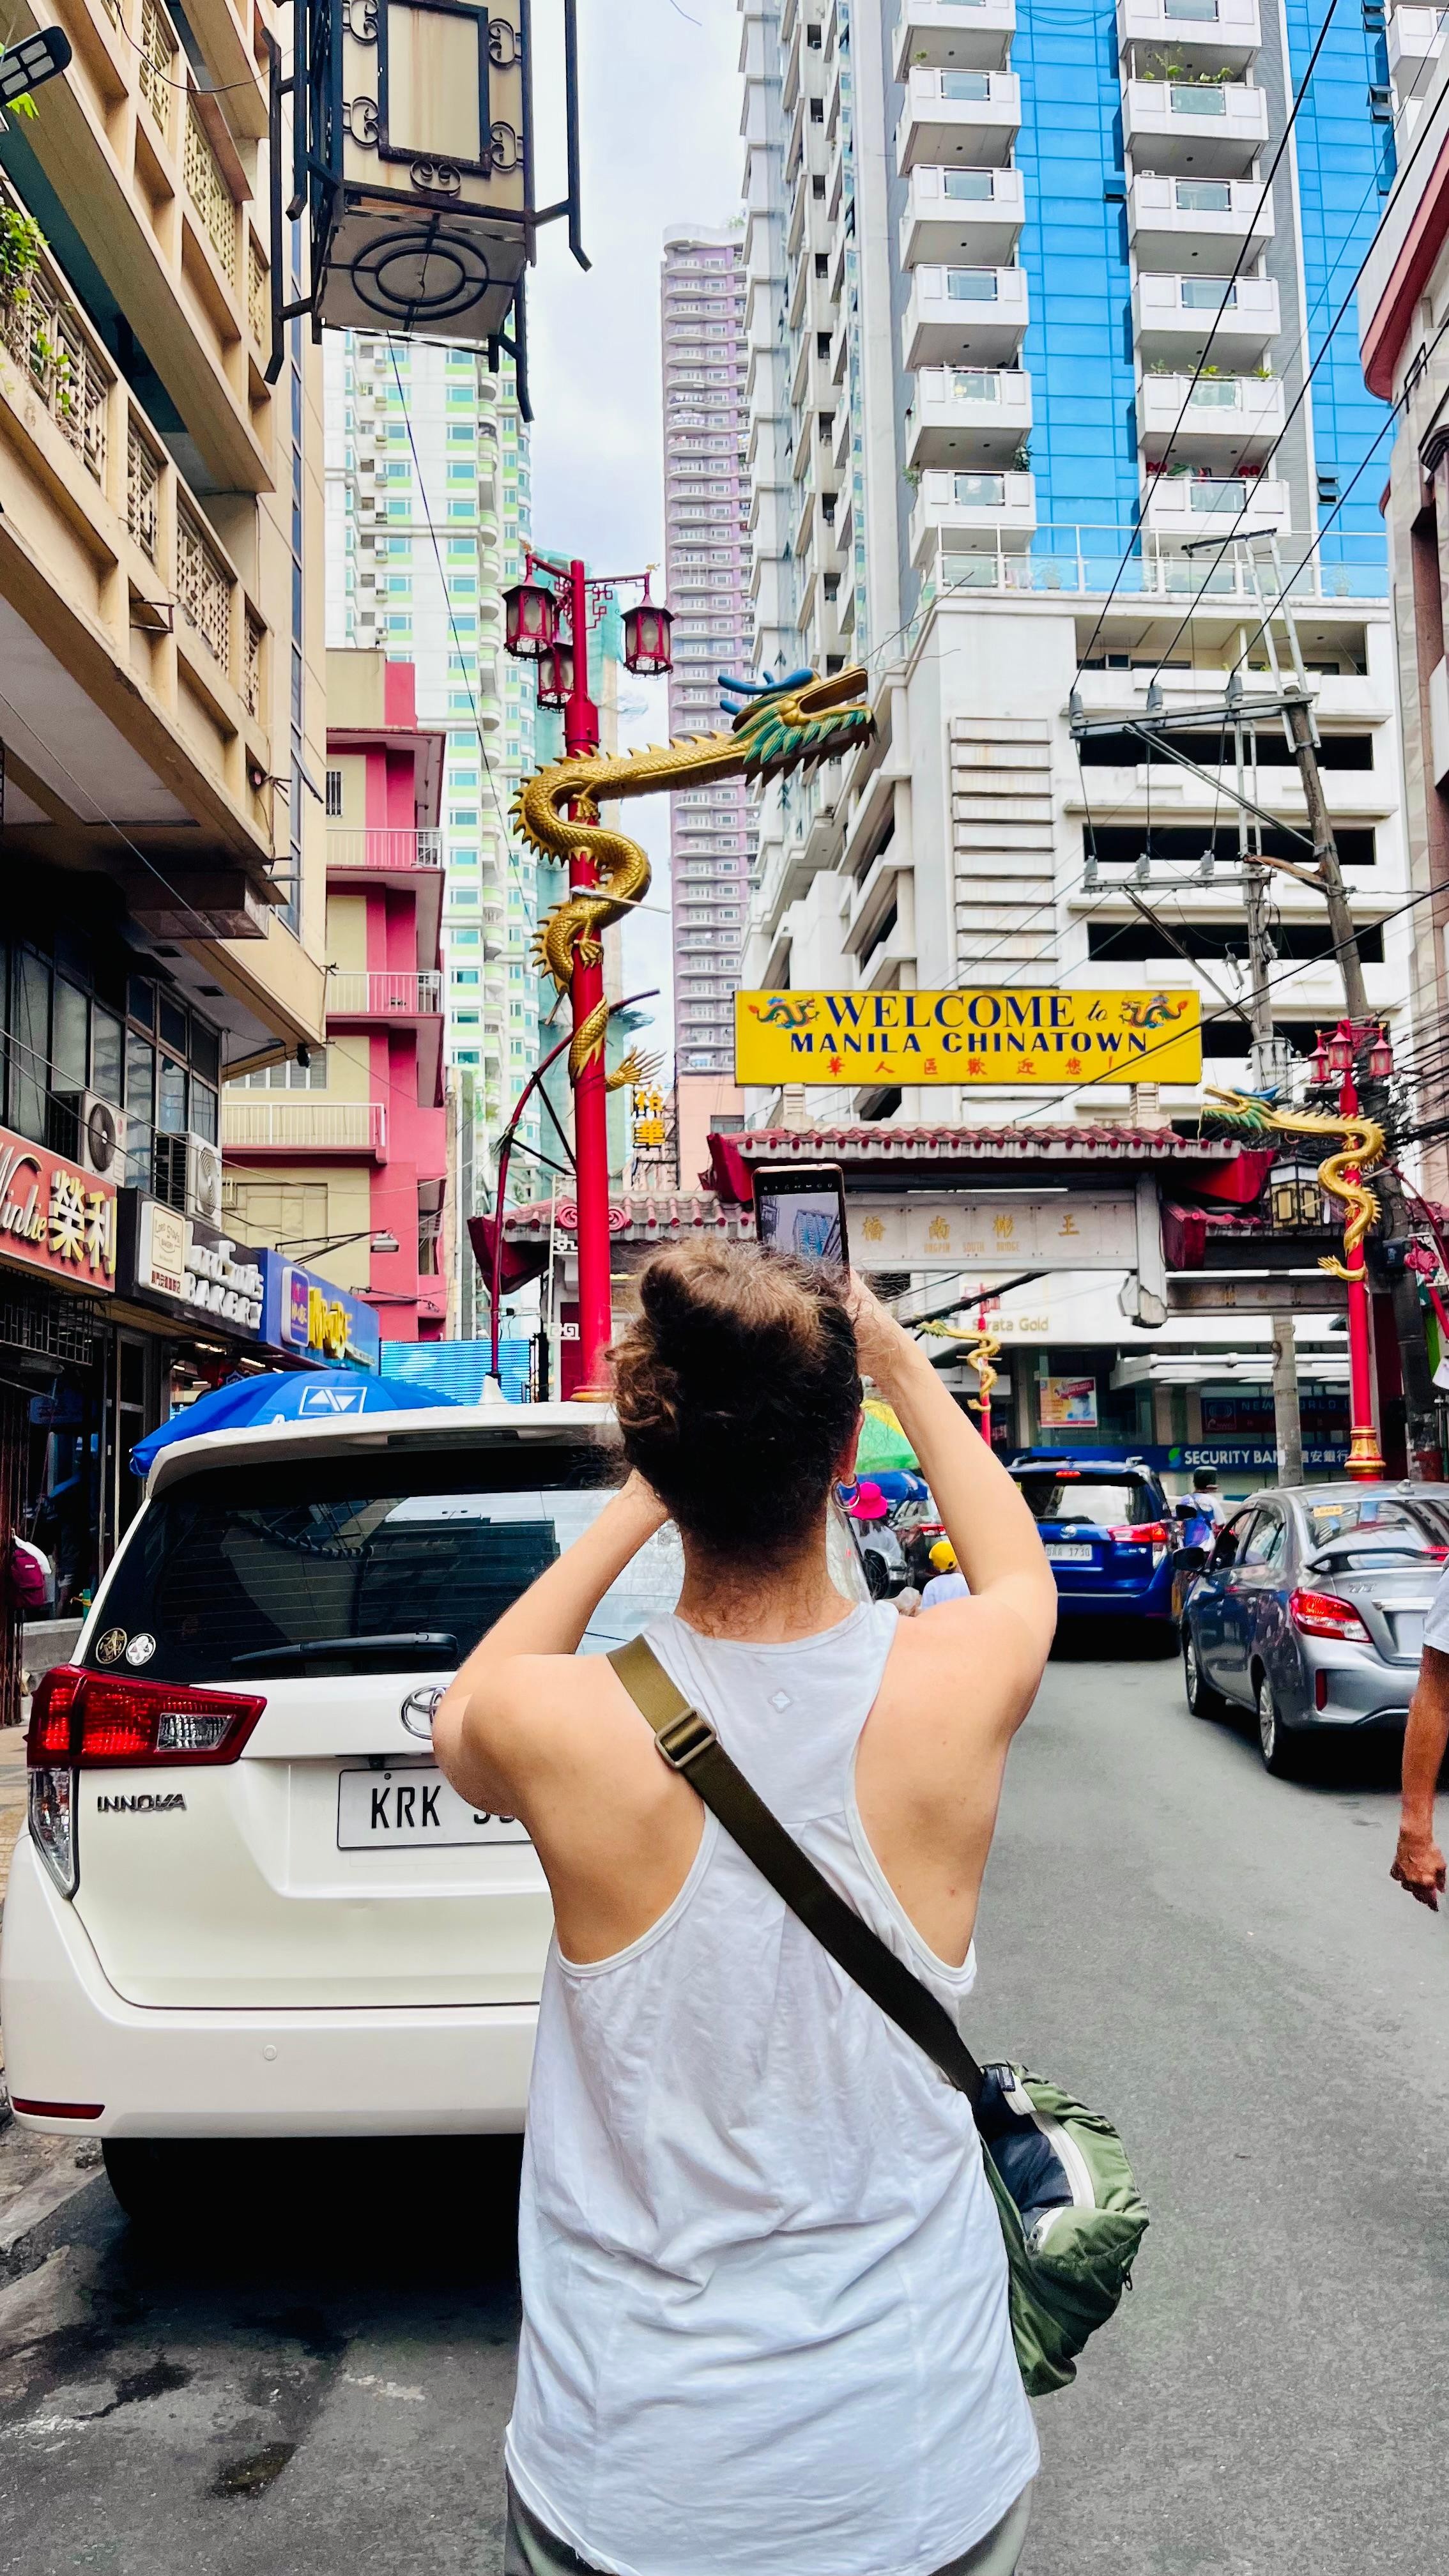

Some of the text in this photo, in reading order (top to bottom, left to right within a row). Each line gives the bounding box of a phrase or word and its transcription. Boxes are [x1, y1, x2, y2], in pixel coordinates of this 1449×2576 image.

[824, 995, 1108, 1028] WELCOME to
[791, 1032, 1147, 1053] MANILA CHINATOWN
[49, 1169, 118, 1275] 榮利
[962, 1241, 985, 1253] SOUTH
[185, 1272, 263, 1330] BAKERY
[1019, 1316, 1049, 1331] Gold
[1184, 1450, 1250, 1465] SECURITY
[97, 1793, 187, 1813] INNOVA
[371, 1785, 441, 1828] KRK
